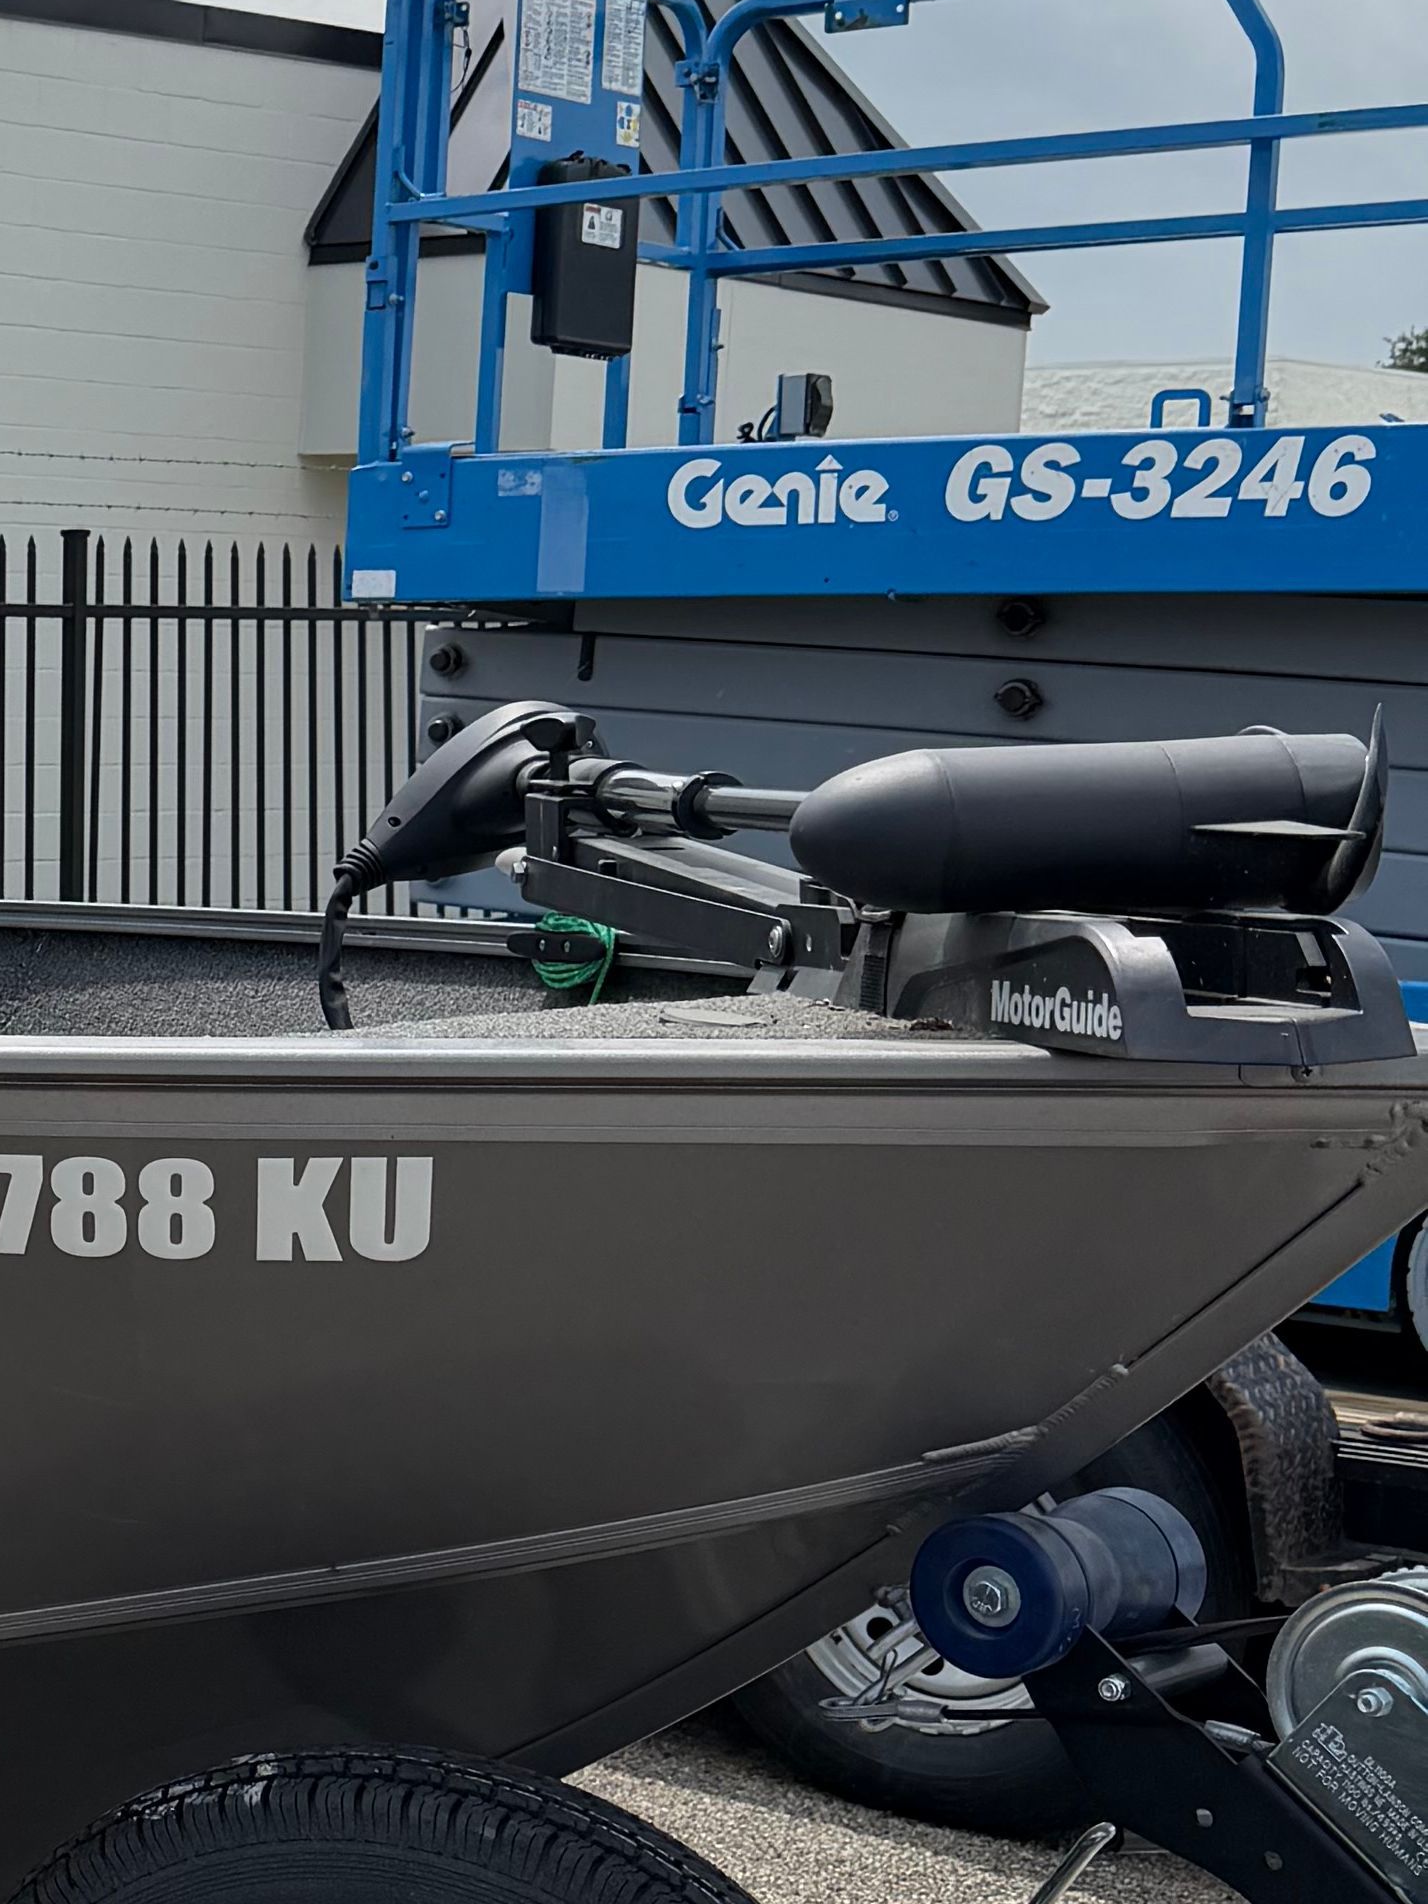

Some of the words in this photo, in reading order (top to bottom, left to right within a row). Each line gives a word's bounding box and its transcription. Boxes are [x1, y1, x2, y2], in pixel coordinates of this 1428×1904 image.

[667, 454, 890, 529] Genie
[944, 434, 1377, 523] GS-3246
[990, 979, 1123, 1041] MotorGuide
[256, 1156, 435, 1262] KU
[1302, 1739, 1343, 1779] CAPACITY
[1292, 1746, 1317, 1769] NOT
[1315, 1769, 1340, 1793] FOR
[1338, 1792, 1380, 1834] MOVING
[1378, 1832, 1423, 1877] HUMANS
